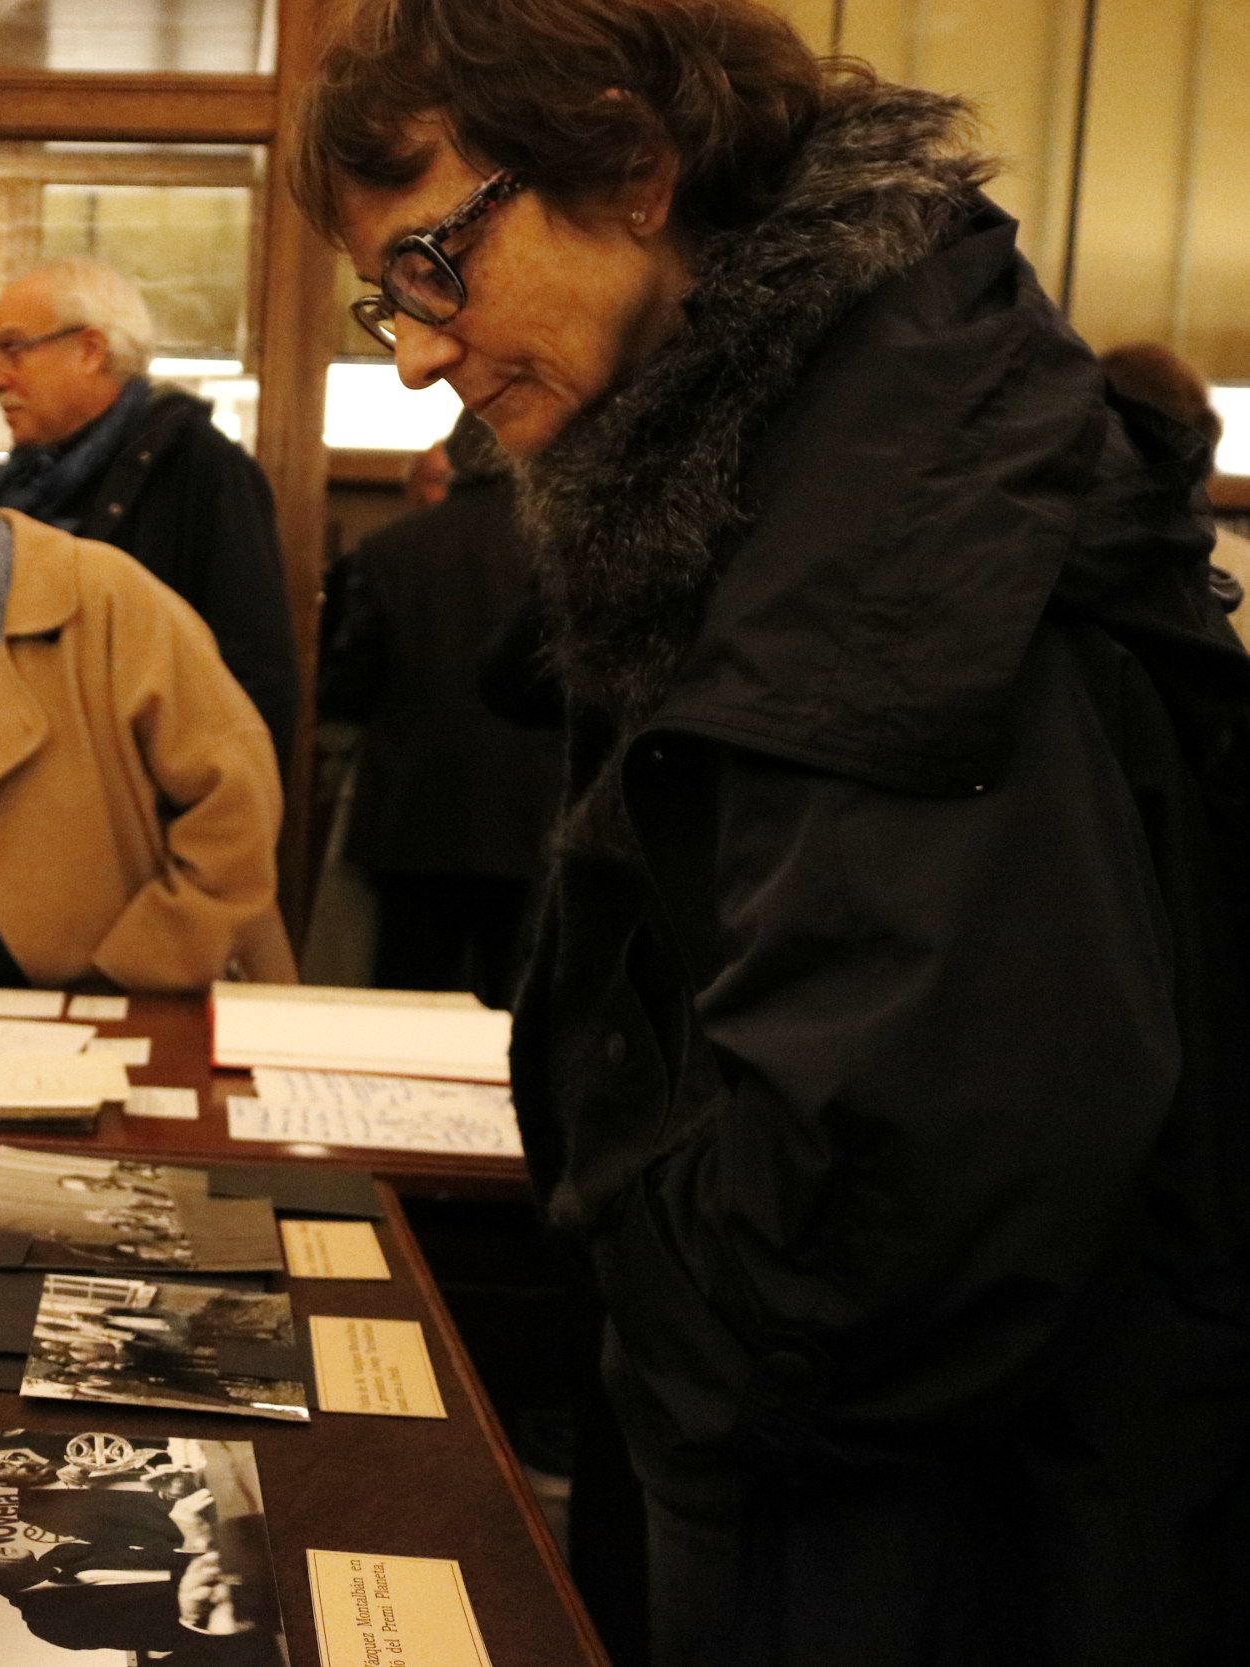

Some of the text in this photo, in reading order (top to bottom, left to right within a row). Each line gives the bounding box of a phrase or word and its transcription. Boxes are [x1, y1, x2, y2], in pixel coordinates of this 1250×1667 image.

[350, 1560, 362, 1572] en
[350, 1576, 372, 1627] Montalbán
[377, 1605, 398, 1632] Premi
[384, 1639, 402, 1654] del
